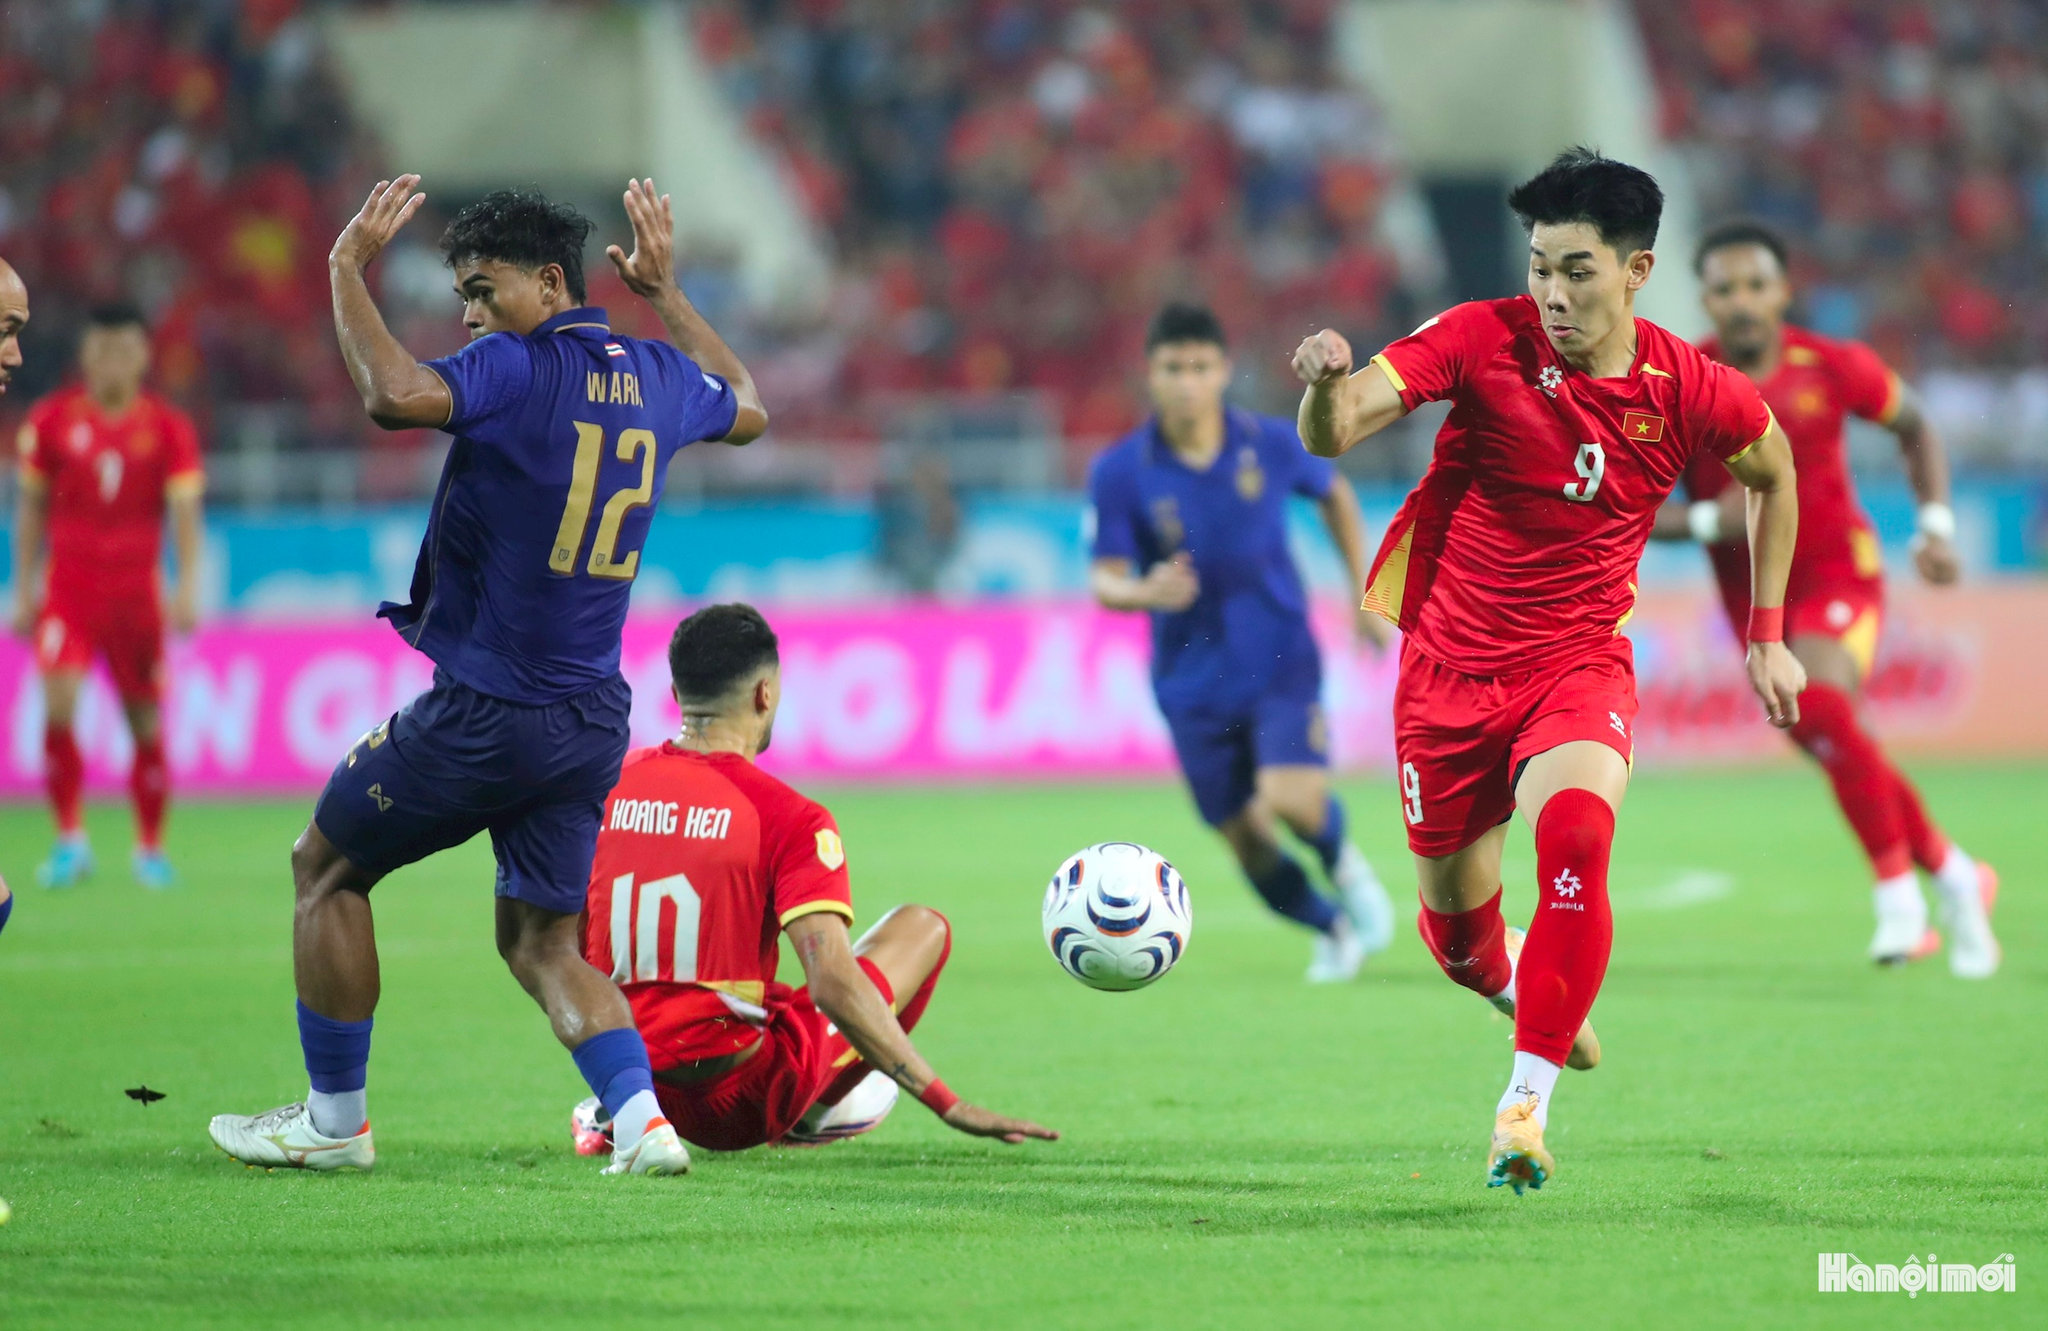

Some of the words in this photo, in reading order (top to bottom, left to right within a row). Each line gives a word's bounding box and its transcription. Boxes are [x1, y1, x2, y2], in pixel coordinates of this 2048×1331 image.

[548, 420, 657, 580] 12
[1562, 442, 1606, 502] 9
[610, 798, 679, 836] HOANG
[683, 805, 732, 840] HEN
[1402, 761, 1425, 826] 9
[610, 871, 702, 985] 10
